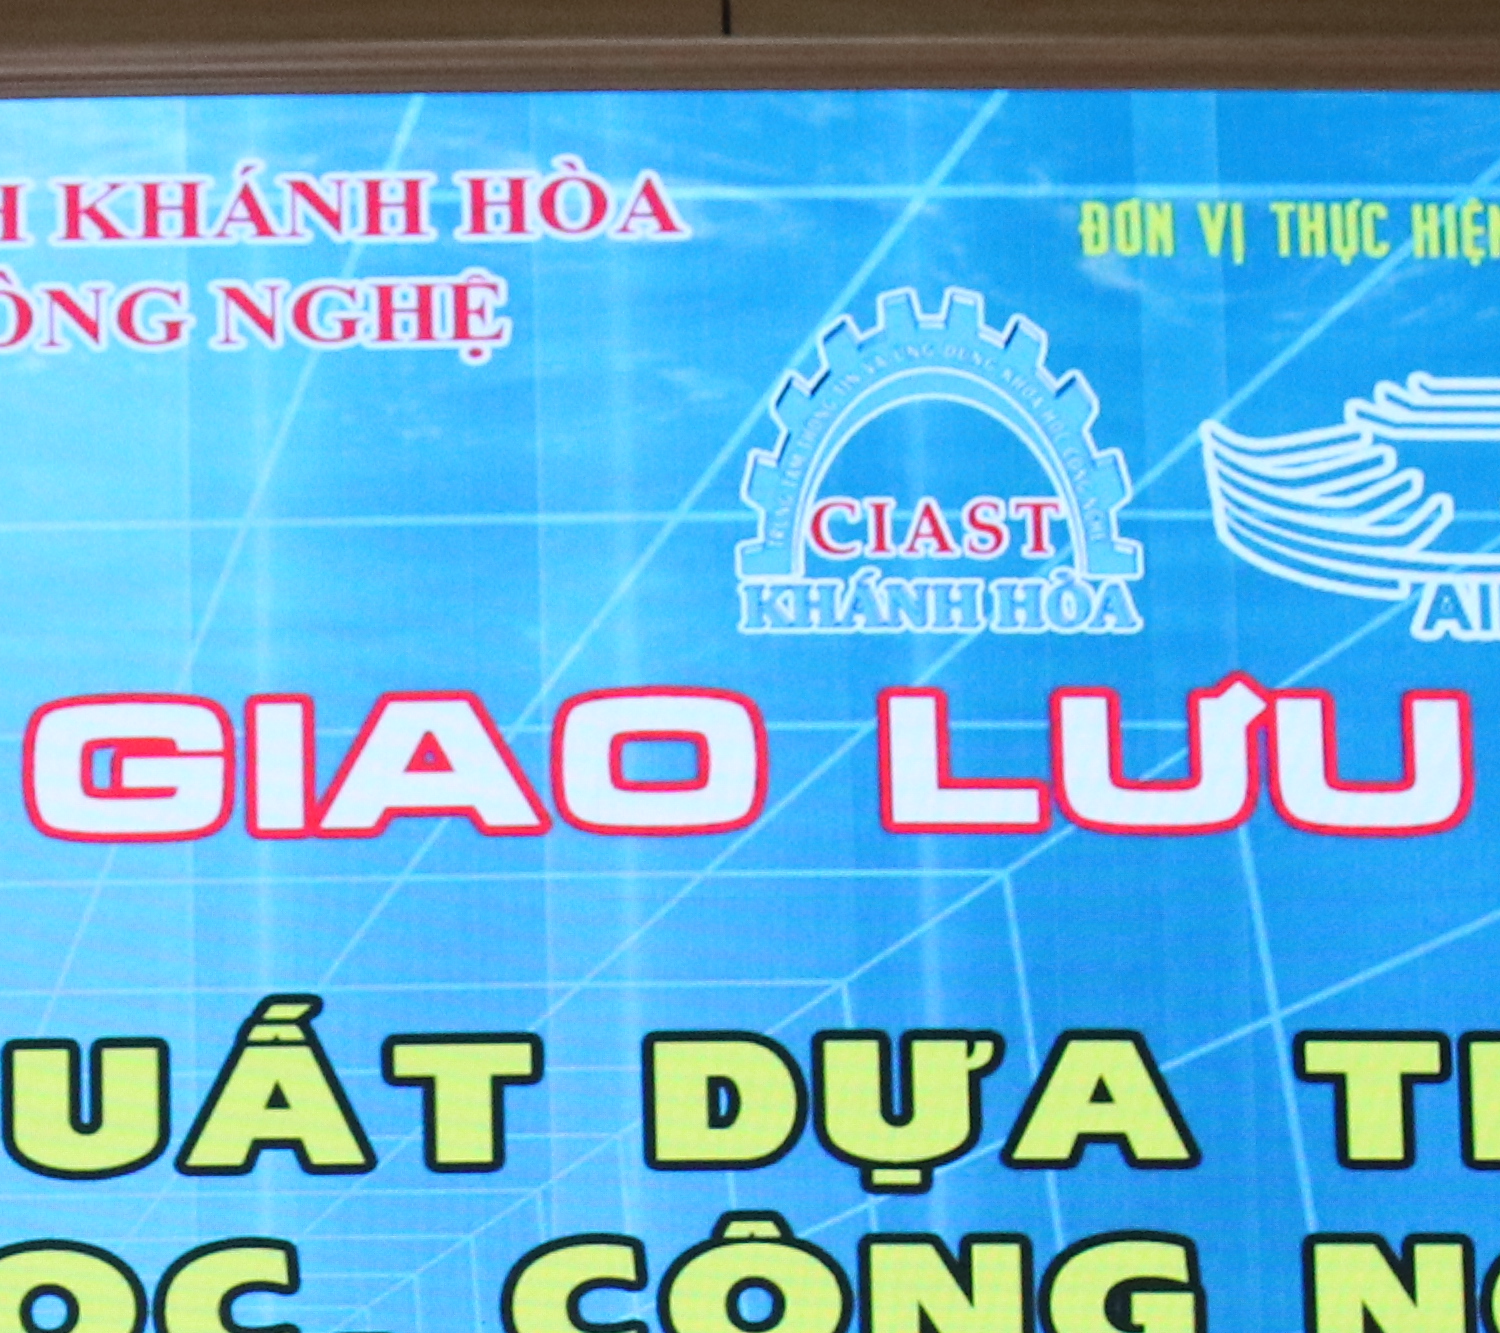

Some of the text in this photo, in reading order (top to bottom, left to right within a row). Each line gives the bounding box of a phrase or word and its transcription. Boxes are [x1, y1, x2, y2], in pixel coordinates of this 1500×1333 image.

[53, 160, 436, 252] KHÁNH
[456, 150, 688, 245] HÒA
[1078, 196, 1174, 258] ĐƠN
[1197, 201, 1244, 264] VỊ
[1270, 196, 1390, 266] THỰC
[214, 274, 512, 364] NGHỆ
[808, 498, 1065, 558] CIAST
[739, 566, 986, 634] KHÁNH
[25, 688, 767, 842] GIAO
[876, 671, 1473, 837] LƯU
[641, 1030, 1200, 1194] DỰA
